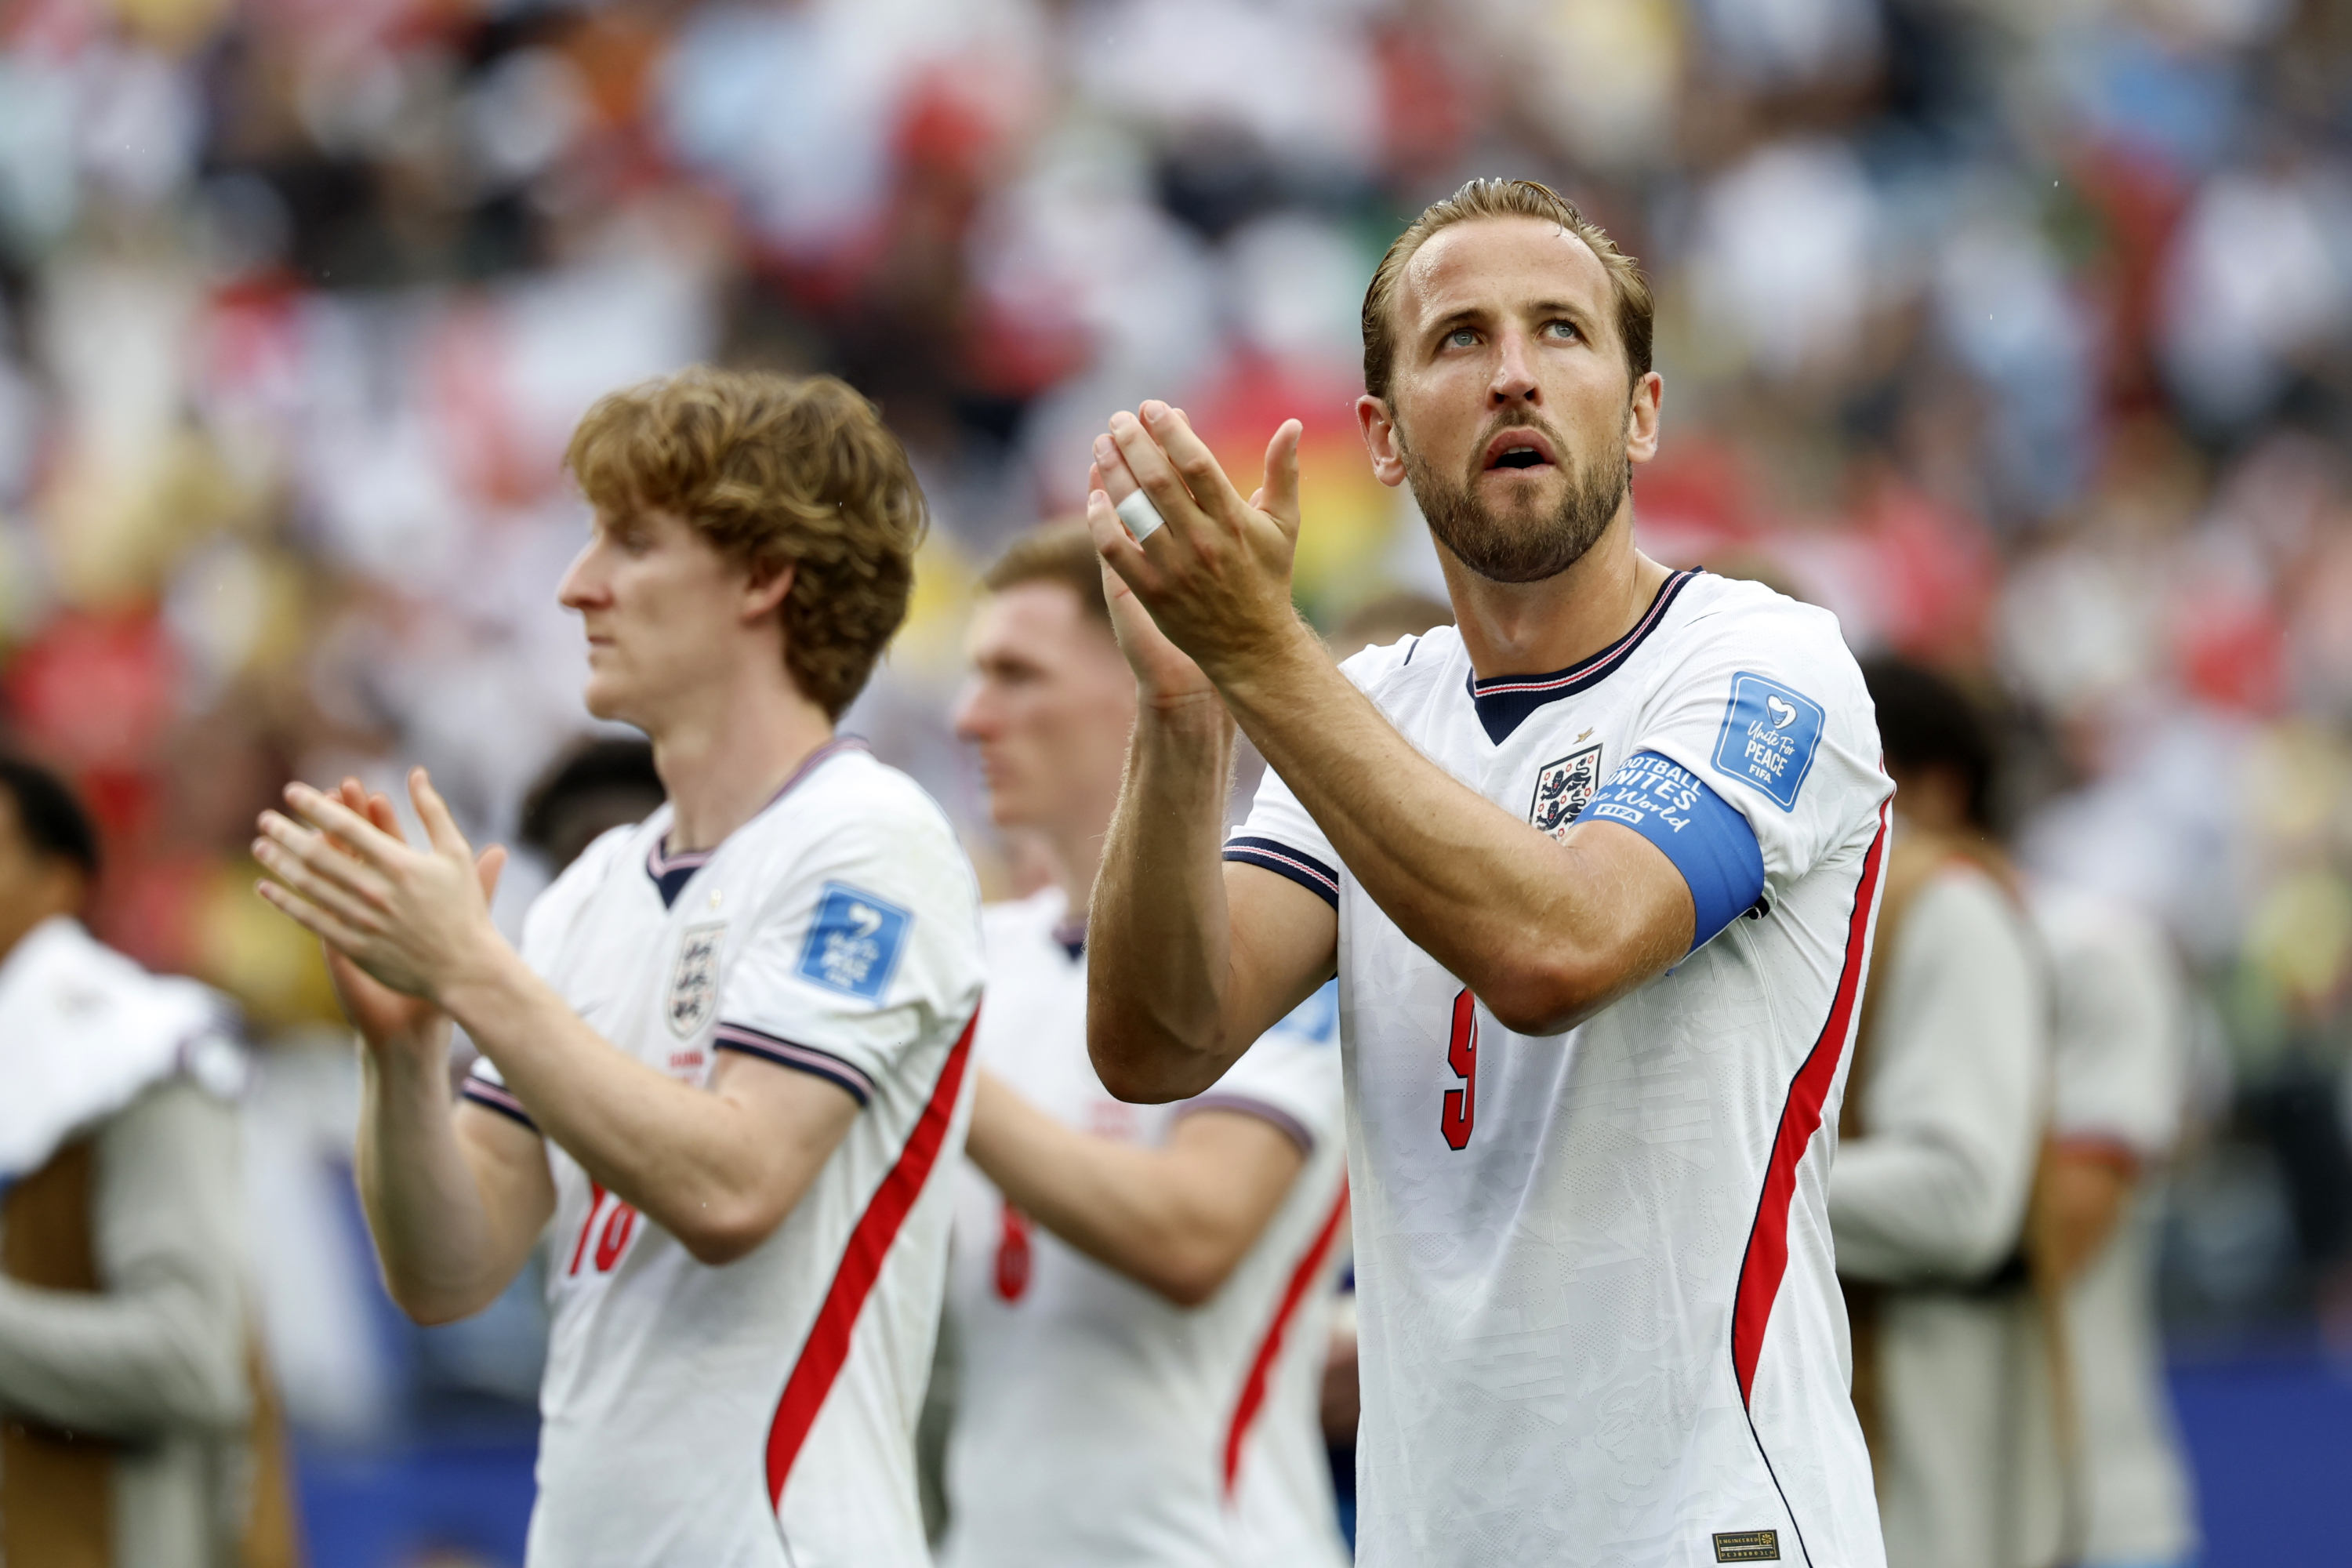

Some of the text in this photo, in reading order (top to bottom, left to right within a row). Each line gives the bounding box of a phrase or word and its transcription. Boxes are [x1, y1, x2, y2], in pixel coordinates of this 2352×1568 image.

[1748, 720, 1795, 755] Unite For
[1618, 757, 1701, 797] OOTBALL
[1744, 739, 1788, 778] PEACE
[1748, 764, 1771, 784] FIFA
[1599, 805, 1637, 821] FIFA
[1613, 787, 1691, 833] World
[1441, 986, 1479, 1151] 9
